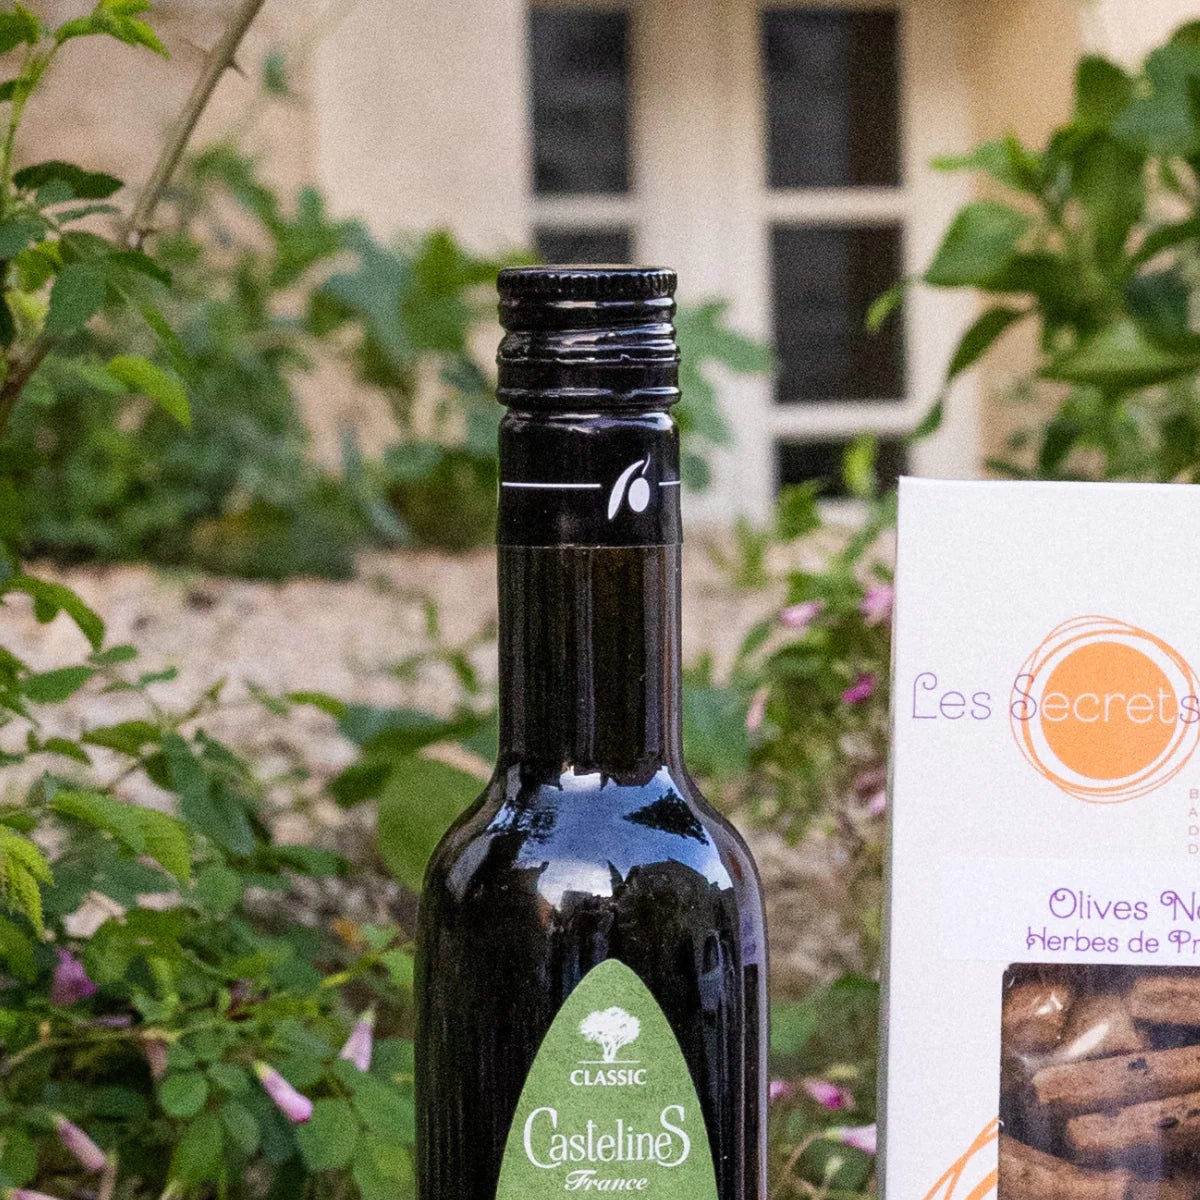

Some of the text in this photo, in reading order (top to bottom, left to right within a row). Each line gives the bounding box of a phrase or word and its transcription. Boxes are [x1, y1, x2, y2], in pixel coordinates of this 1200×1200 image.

[911, 672, 992, 721] Les
[1048, 887, 1148, 921] Olives
[1025, 926, 1119, 954] Herbes
[1127, 930, 1159, 954] de
[569, 1069, 647, 1086] CLASSIC
[564, 1169, 648, 1191] France
